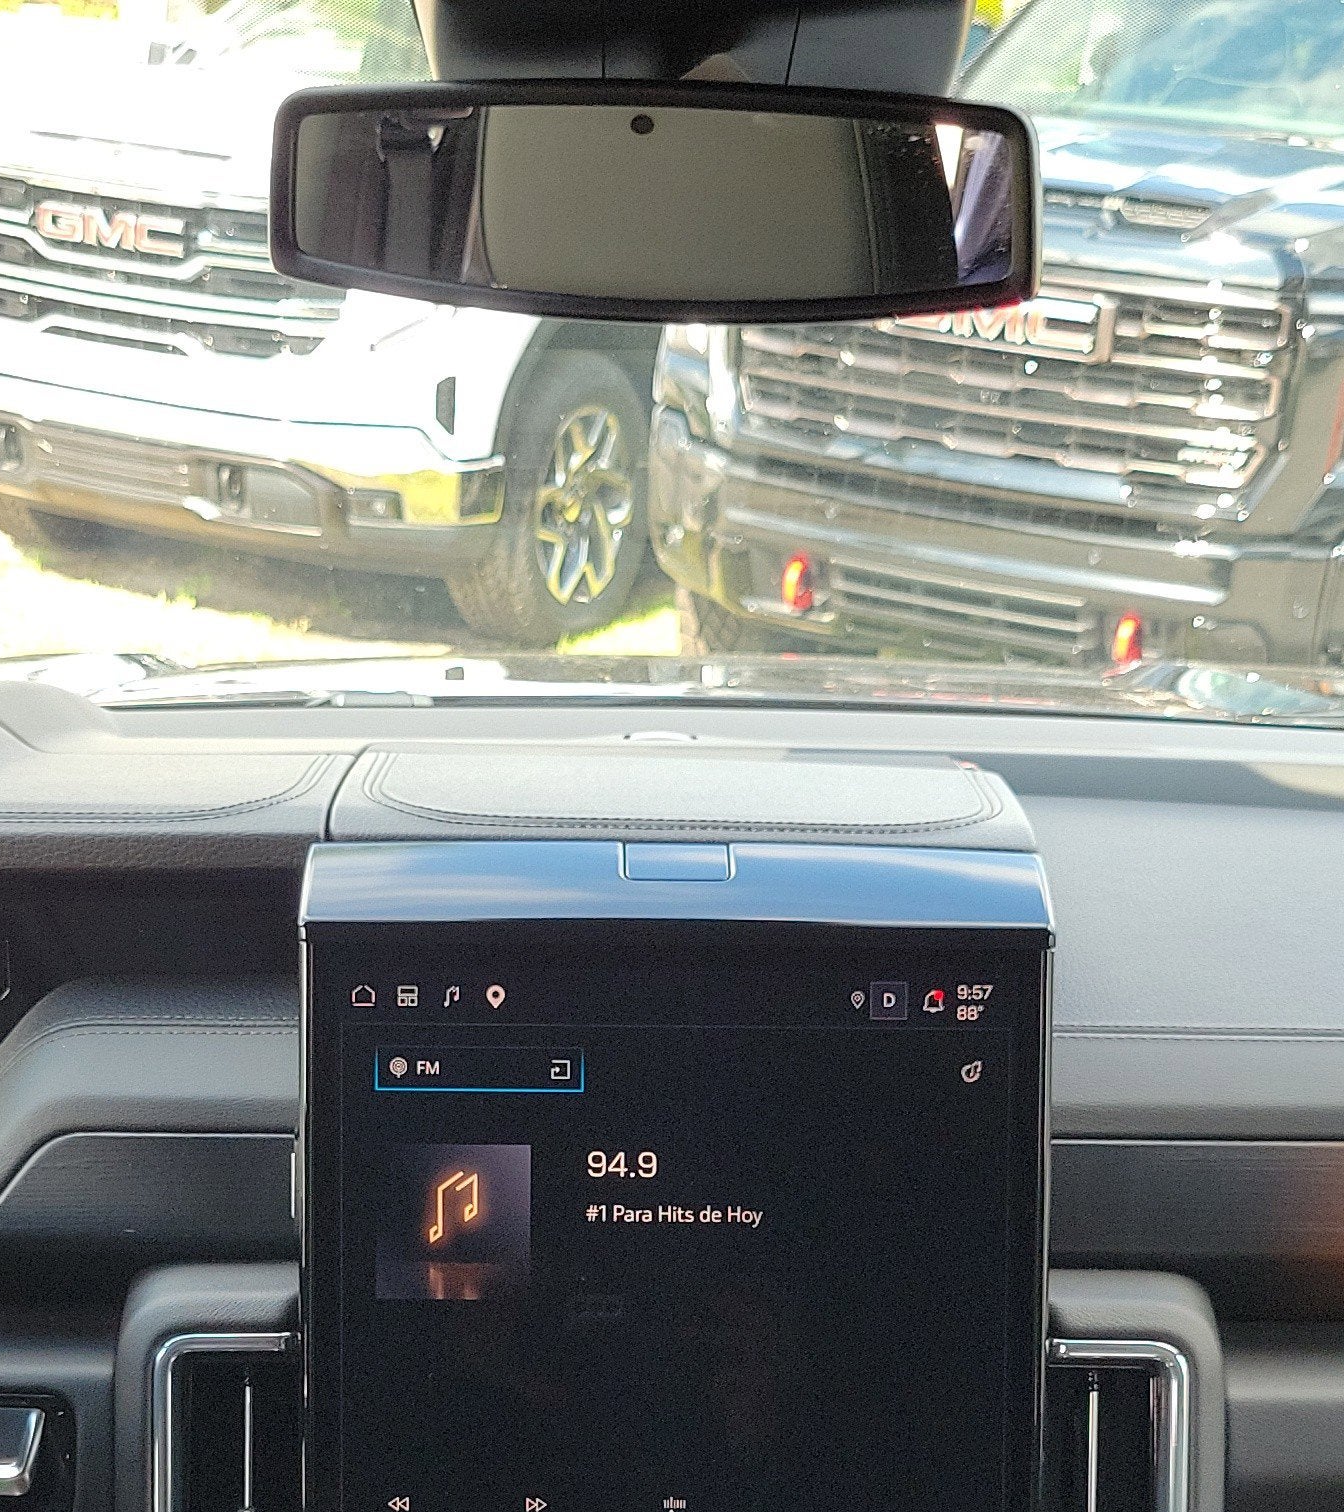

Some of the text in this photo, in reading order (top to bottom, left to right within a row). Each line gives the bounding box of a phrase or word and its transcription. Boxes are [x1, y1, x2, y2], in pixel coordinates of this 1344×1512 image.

[35, 201, 186, 258] GMC
[883, 992, 897, 1008] D
[956, 984, 994, 1000] 9:57
[956, 1005, 986, 1021] 88°
[416, 1061, 440, 1075] FM
[587, 1150, 658, 1178] 94.9
[585, 1204, 764, 1228] #1 Para Hits de Hoy
